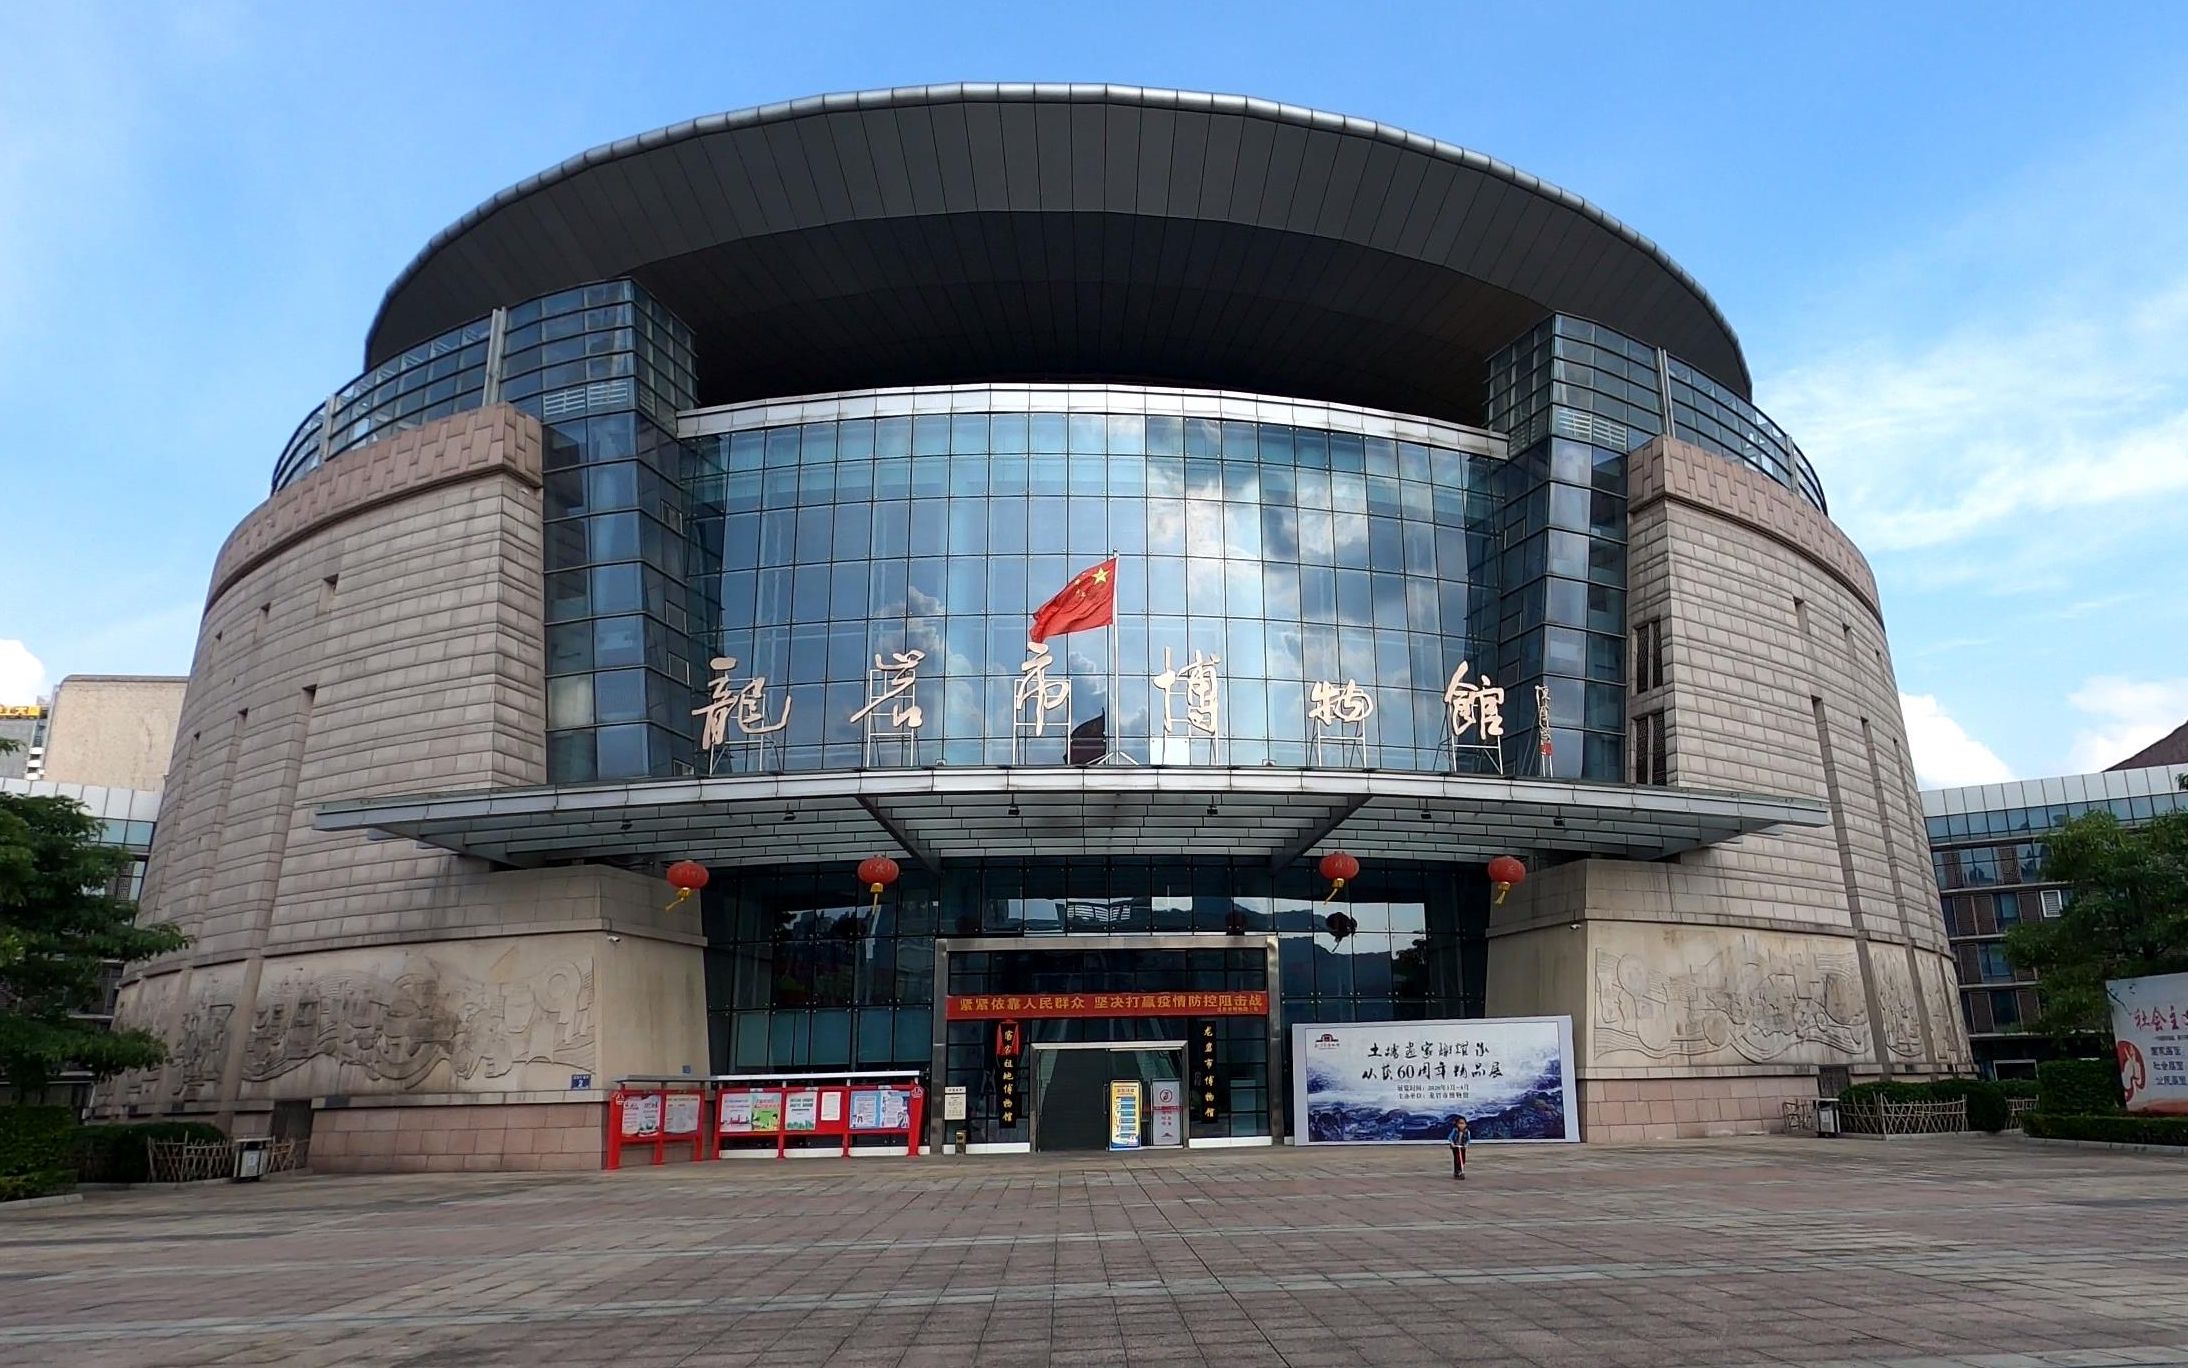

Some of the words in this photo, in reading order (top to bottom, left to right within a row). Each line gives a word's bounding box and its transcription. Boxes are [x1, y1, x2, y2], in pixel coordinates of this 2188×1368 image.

[960, 997, 1085, 1012] 紧紧依靠人民群众
[1094, 994, 1263, 1009] 坚决打赢疫情防控阻击战
